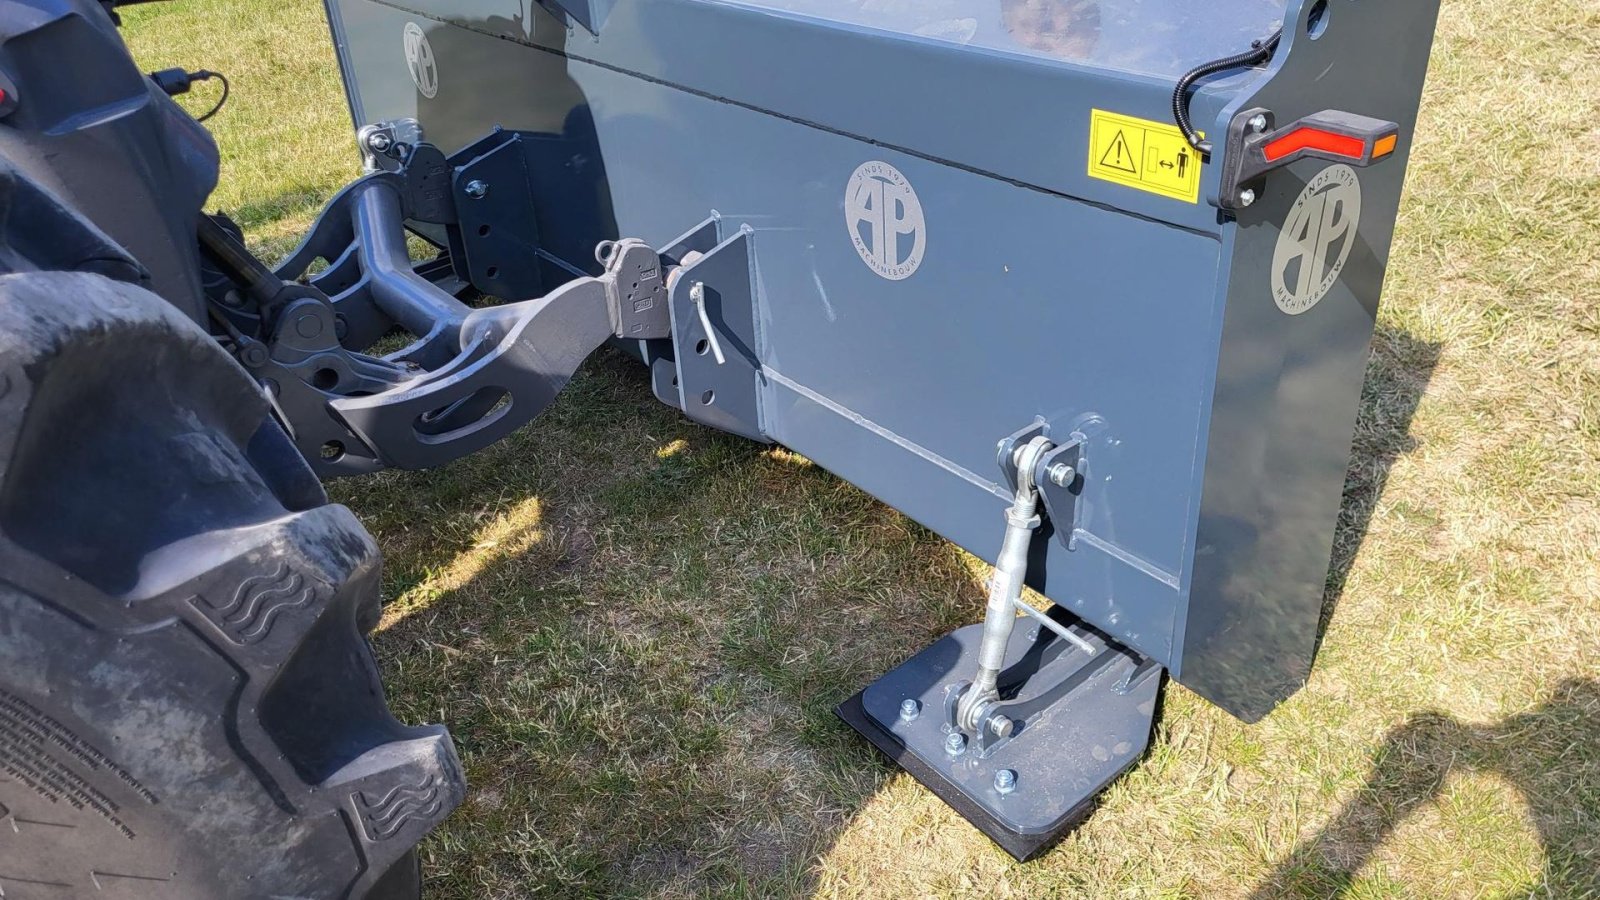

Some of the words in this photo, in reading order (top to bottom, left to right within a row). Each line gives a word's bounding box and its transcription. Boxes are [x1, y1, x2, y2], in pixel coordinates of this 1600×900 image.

[857, 165, 883, 181] SINDS
[887, 169, 911, 194] 1979
[1297, 172, 1330, 208] SINDS
[1335, 169, 1355, 188] 1979
[852, 180, 917, 266] AP
[1286, 191, 1351, 297] AP
[854, 237, 918, 276] MACHINEBOUW
[1275, 259, 1342, 309] MACHINEBOUW
